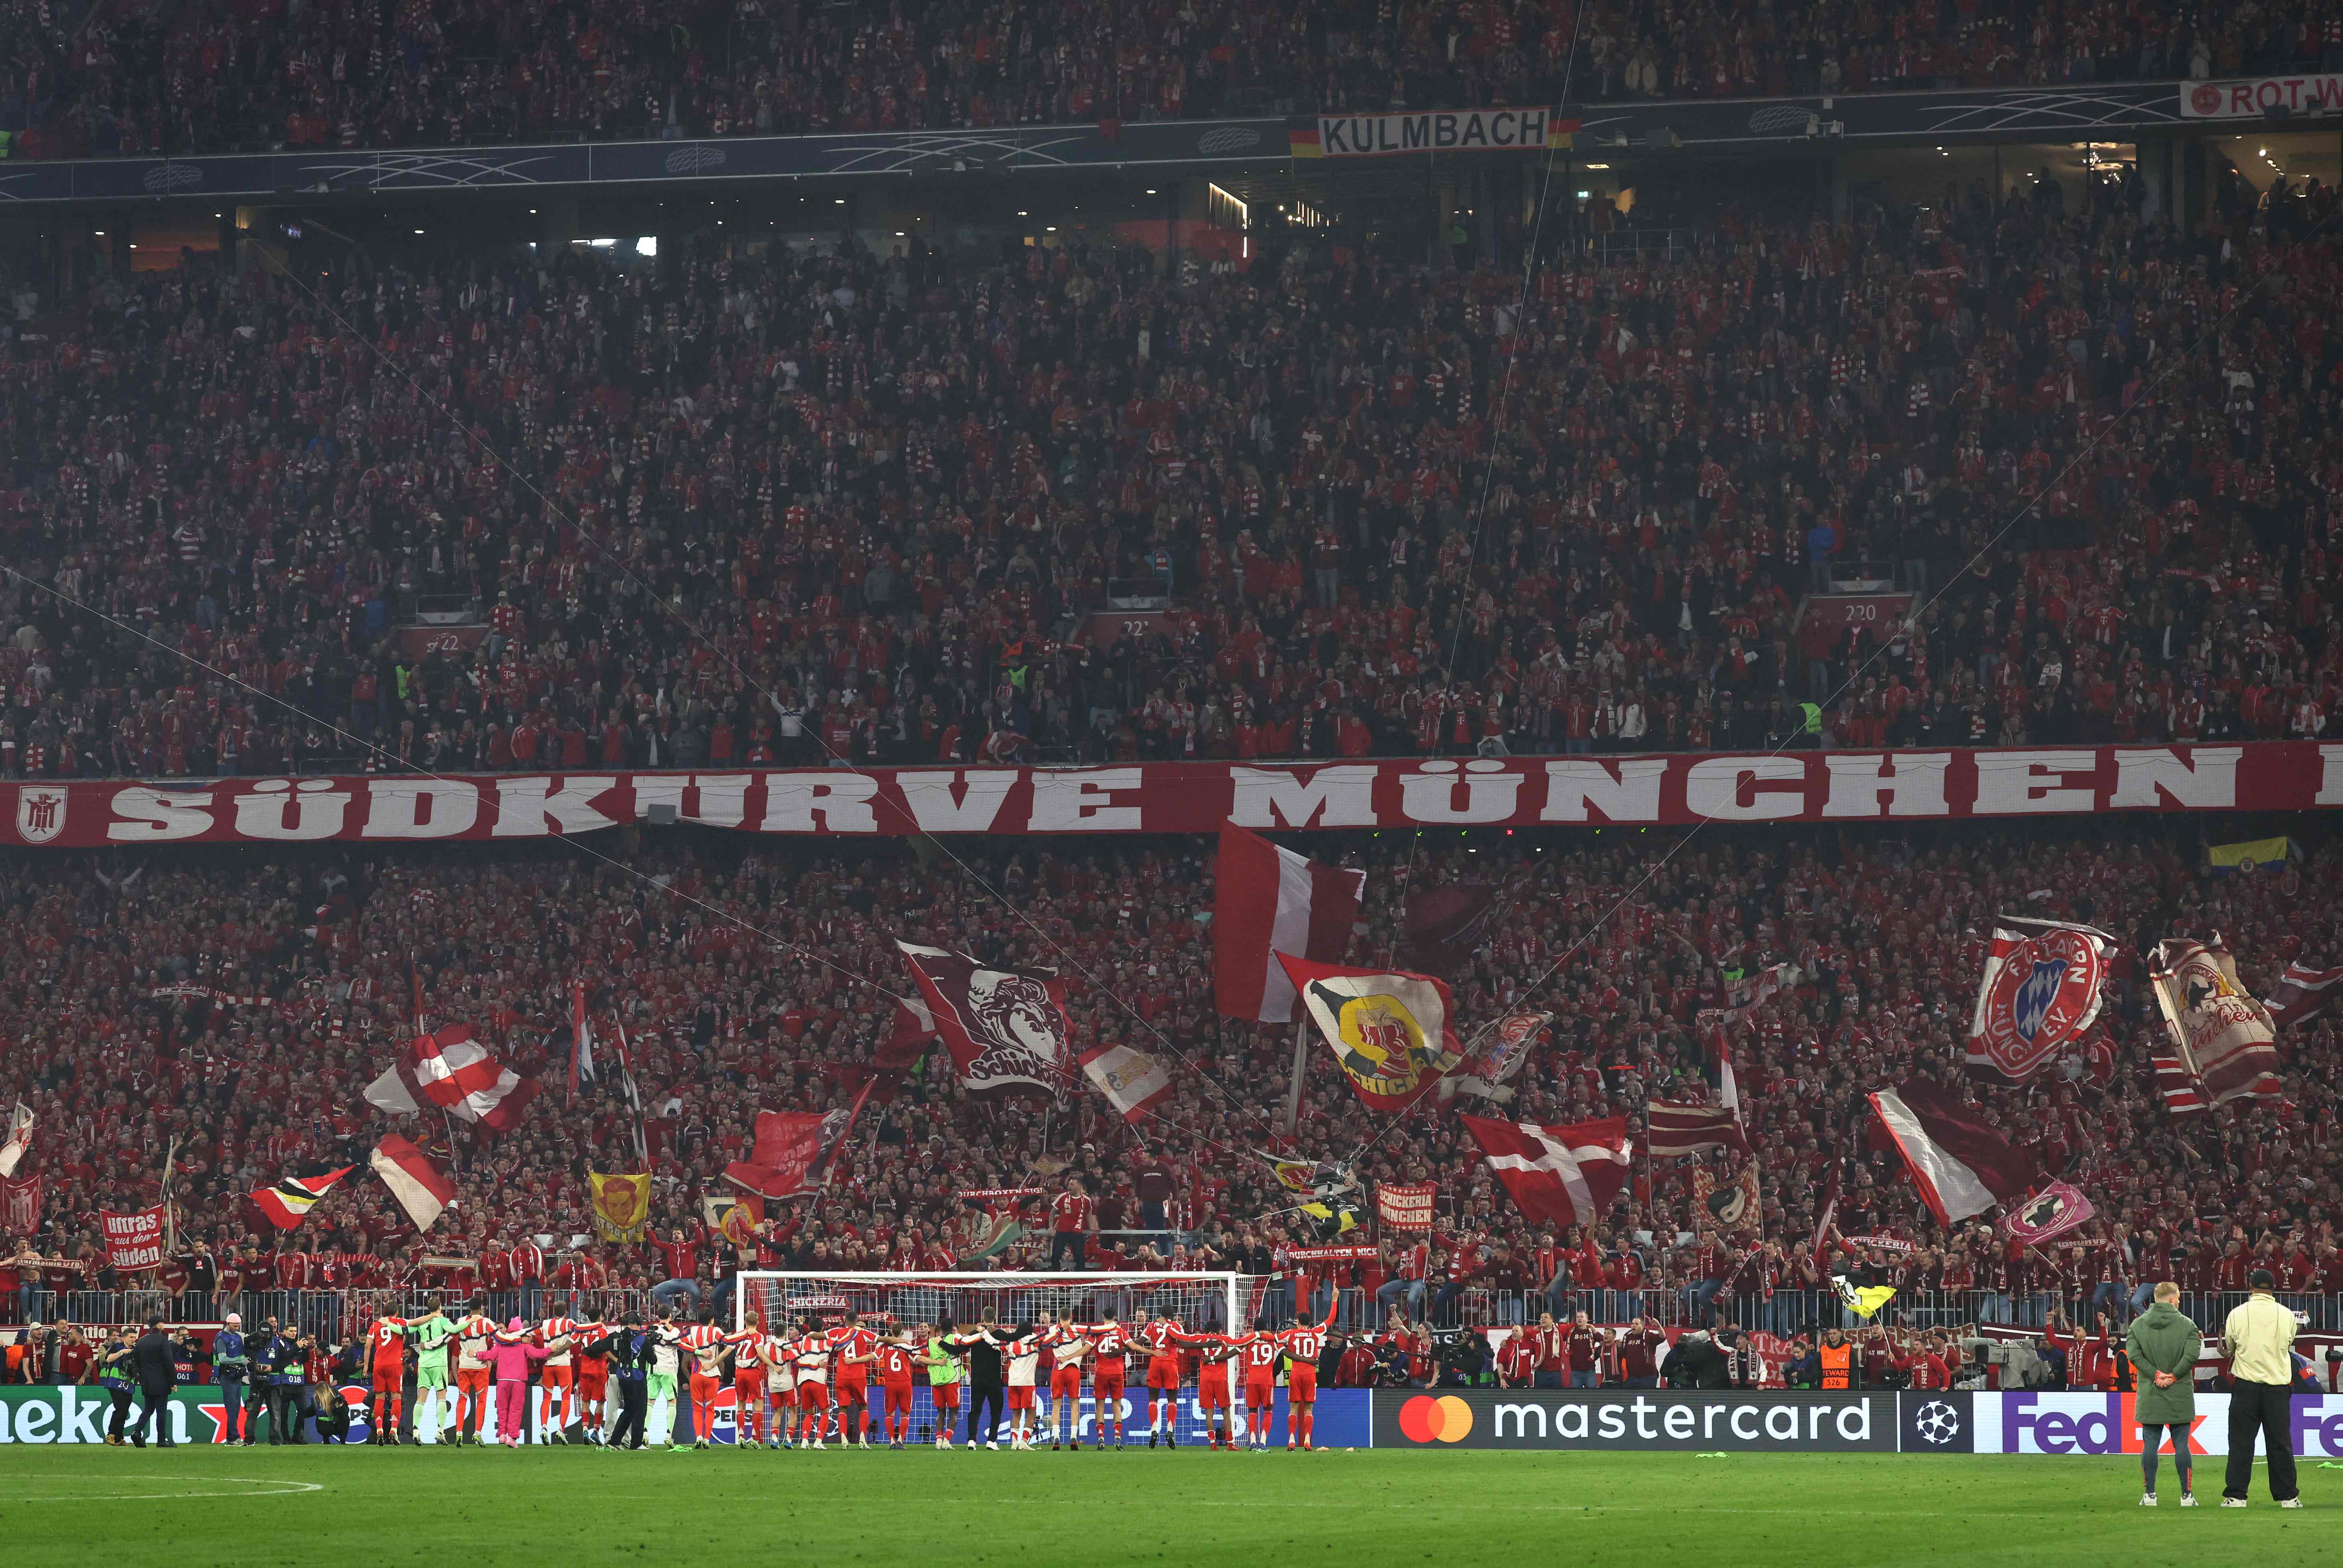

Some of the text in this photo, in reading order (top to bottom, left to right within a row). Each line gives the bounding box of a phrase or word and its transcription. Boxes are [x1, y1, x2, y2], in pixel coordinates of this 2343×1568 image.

[1323, 111, 1545, 152] KULMBACH
[107, 767, 1142, 841] SÜDKURVE
[1227, 746, 2243, 827] MÜNCHEN
[1379, 1189, 1431, 1208] SCHICKERIA
[1380, 1203, 1431, 1222] MÜNCHEN
[108, 1214, 157, 1233] ultras
[115, 1235, 130, 1244] aus
[1846, 1237, 1912, 1251] SCHICKERIA
[112, 1246, 160, 1266] süden
[1289, 1248, 1353, 1259] DURCHHALTEN
[380, 1327, 391, 1346] 9
[426, 1324, 433, 1342] 1
[1155, 1327, 1166, 1348] 2
[844, 1340, 856, 1359] 4
[1098, 1335, 1119, 1353] 45
[1293, 1337, 1314, 1357] 10
[890, 1351, 901, 1371] 6
[1251, 1344, 1273, 1365] 19
[0, 1385, 191, 1443] eken
[1495, 1396, 1870, 1440] mastercard
